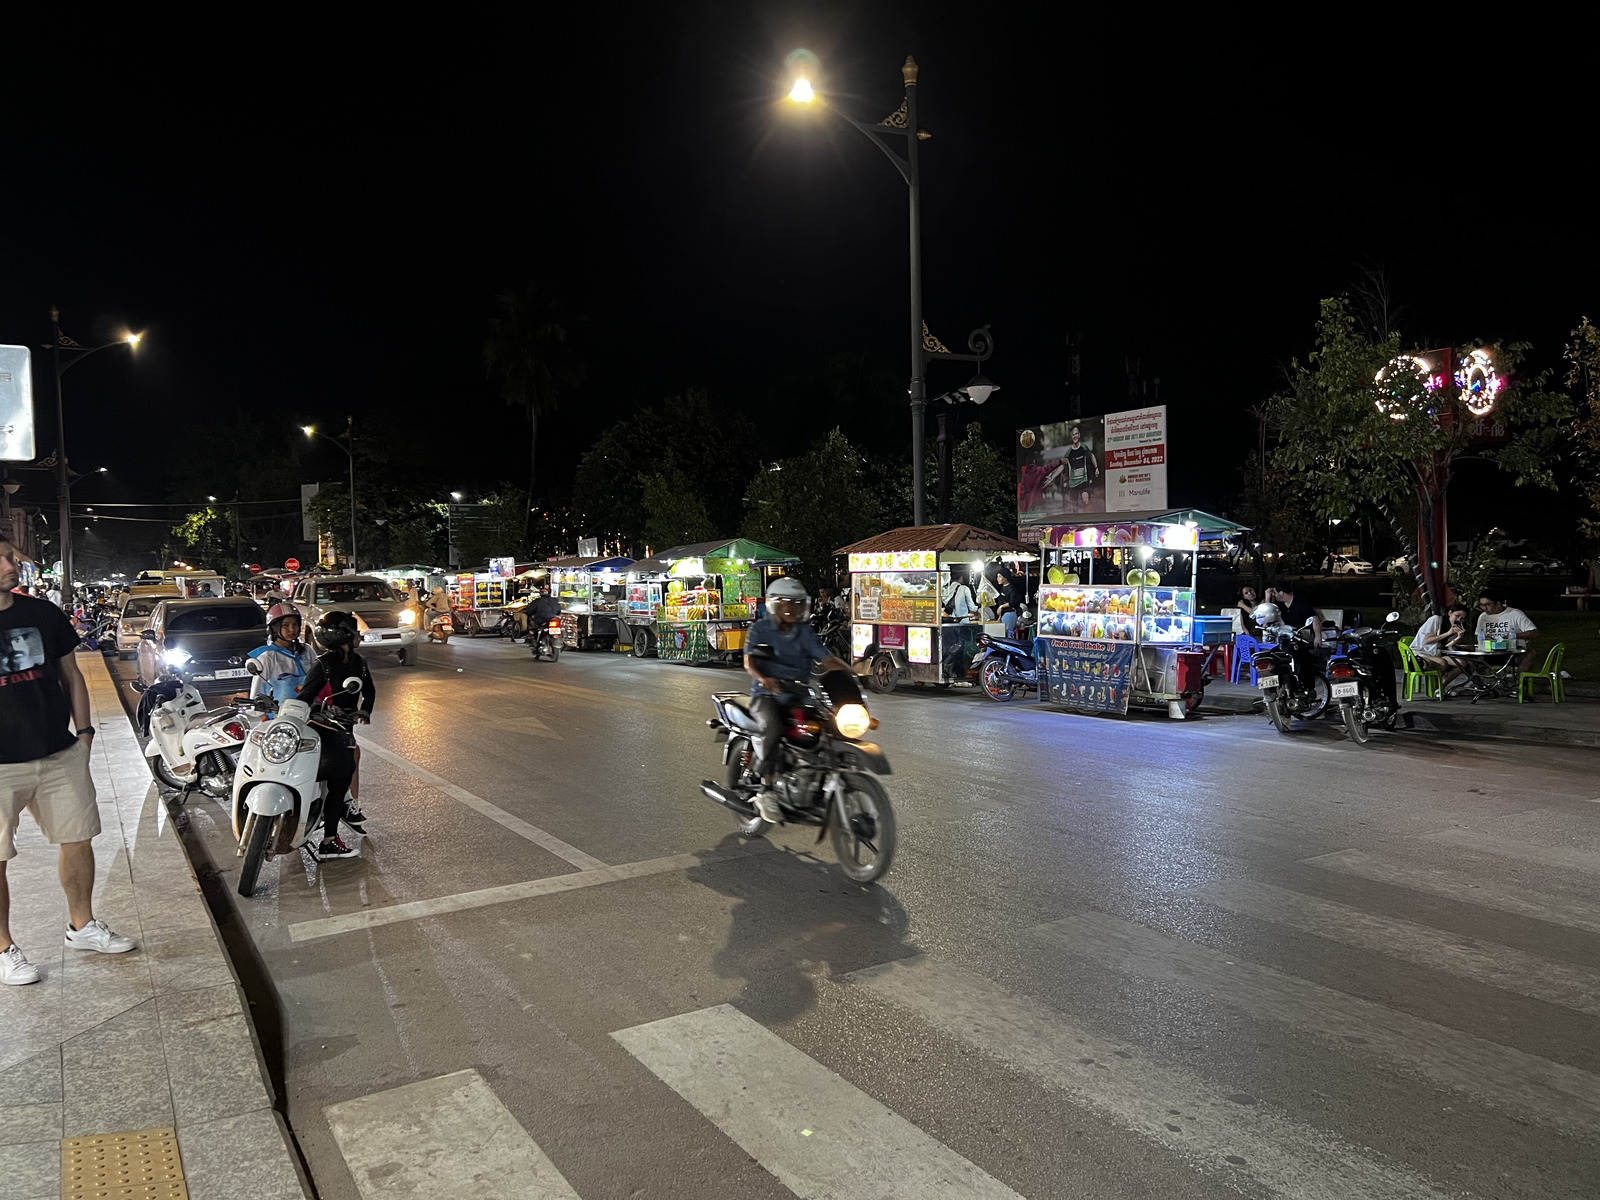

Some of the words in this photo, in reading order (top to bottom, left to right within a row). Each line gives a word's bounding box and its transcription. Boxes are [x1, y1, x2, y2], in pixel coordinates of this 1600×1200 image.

[1129, 488, 1151, 496] Manulife
[1485, 621, 1508, 629] PEACE
[1051, 639, 1068, 648] Fresh
[1069, 641, 1084, 649] Fruit
[1085, 641, 1106, 651] Shake
